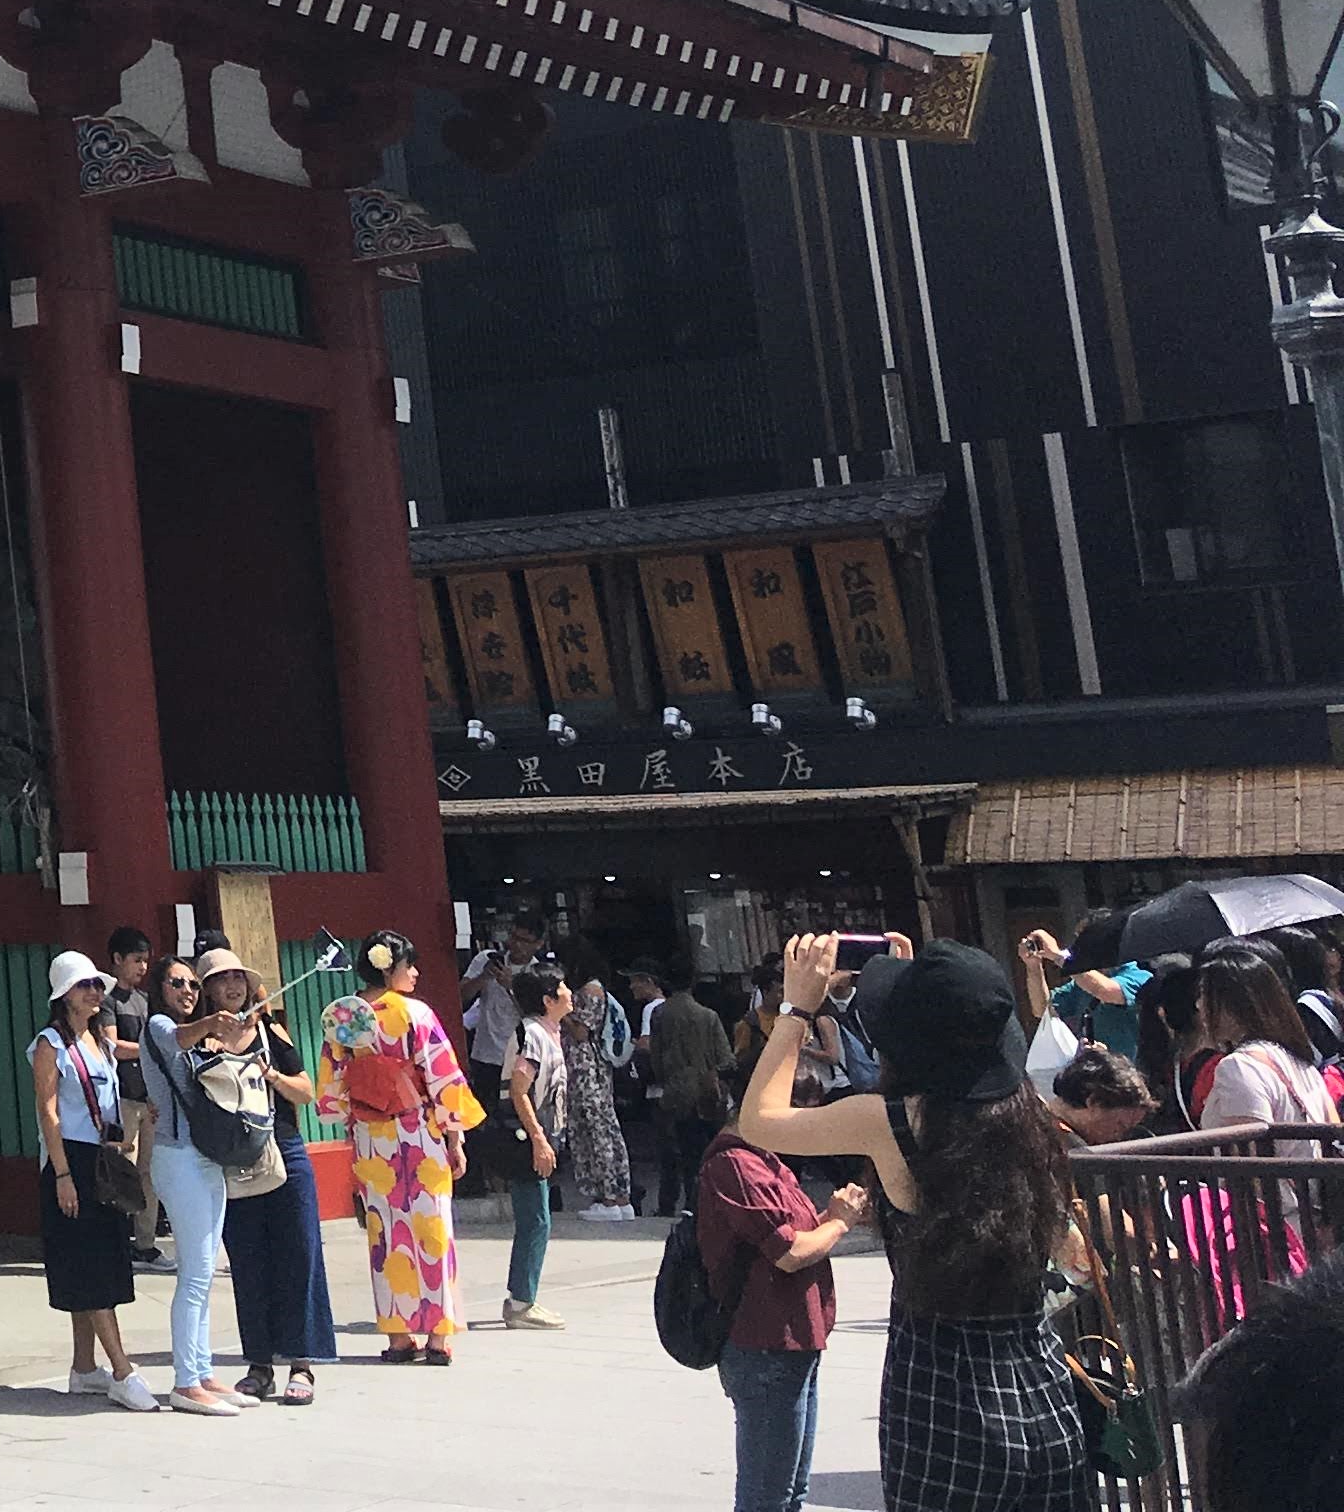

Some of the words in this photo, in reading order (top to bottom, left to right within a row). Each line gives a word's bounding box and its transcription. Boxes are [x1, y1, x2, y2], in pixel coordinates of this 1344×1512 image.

[517, 740, 813, 795] 黒田屋本店
